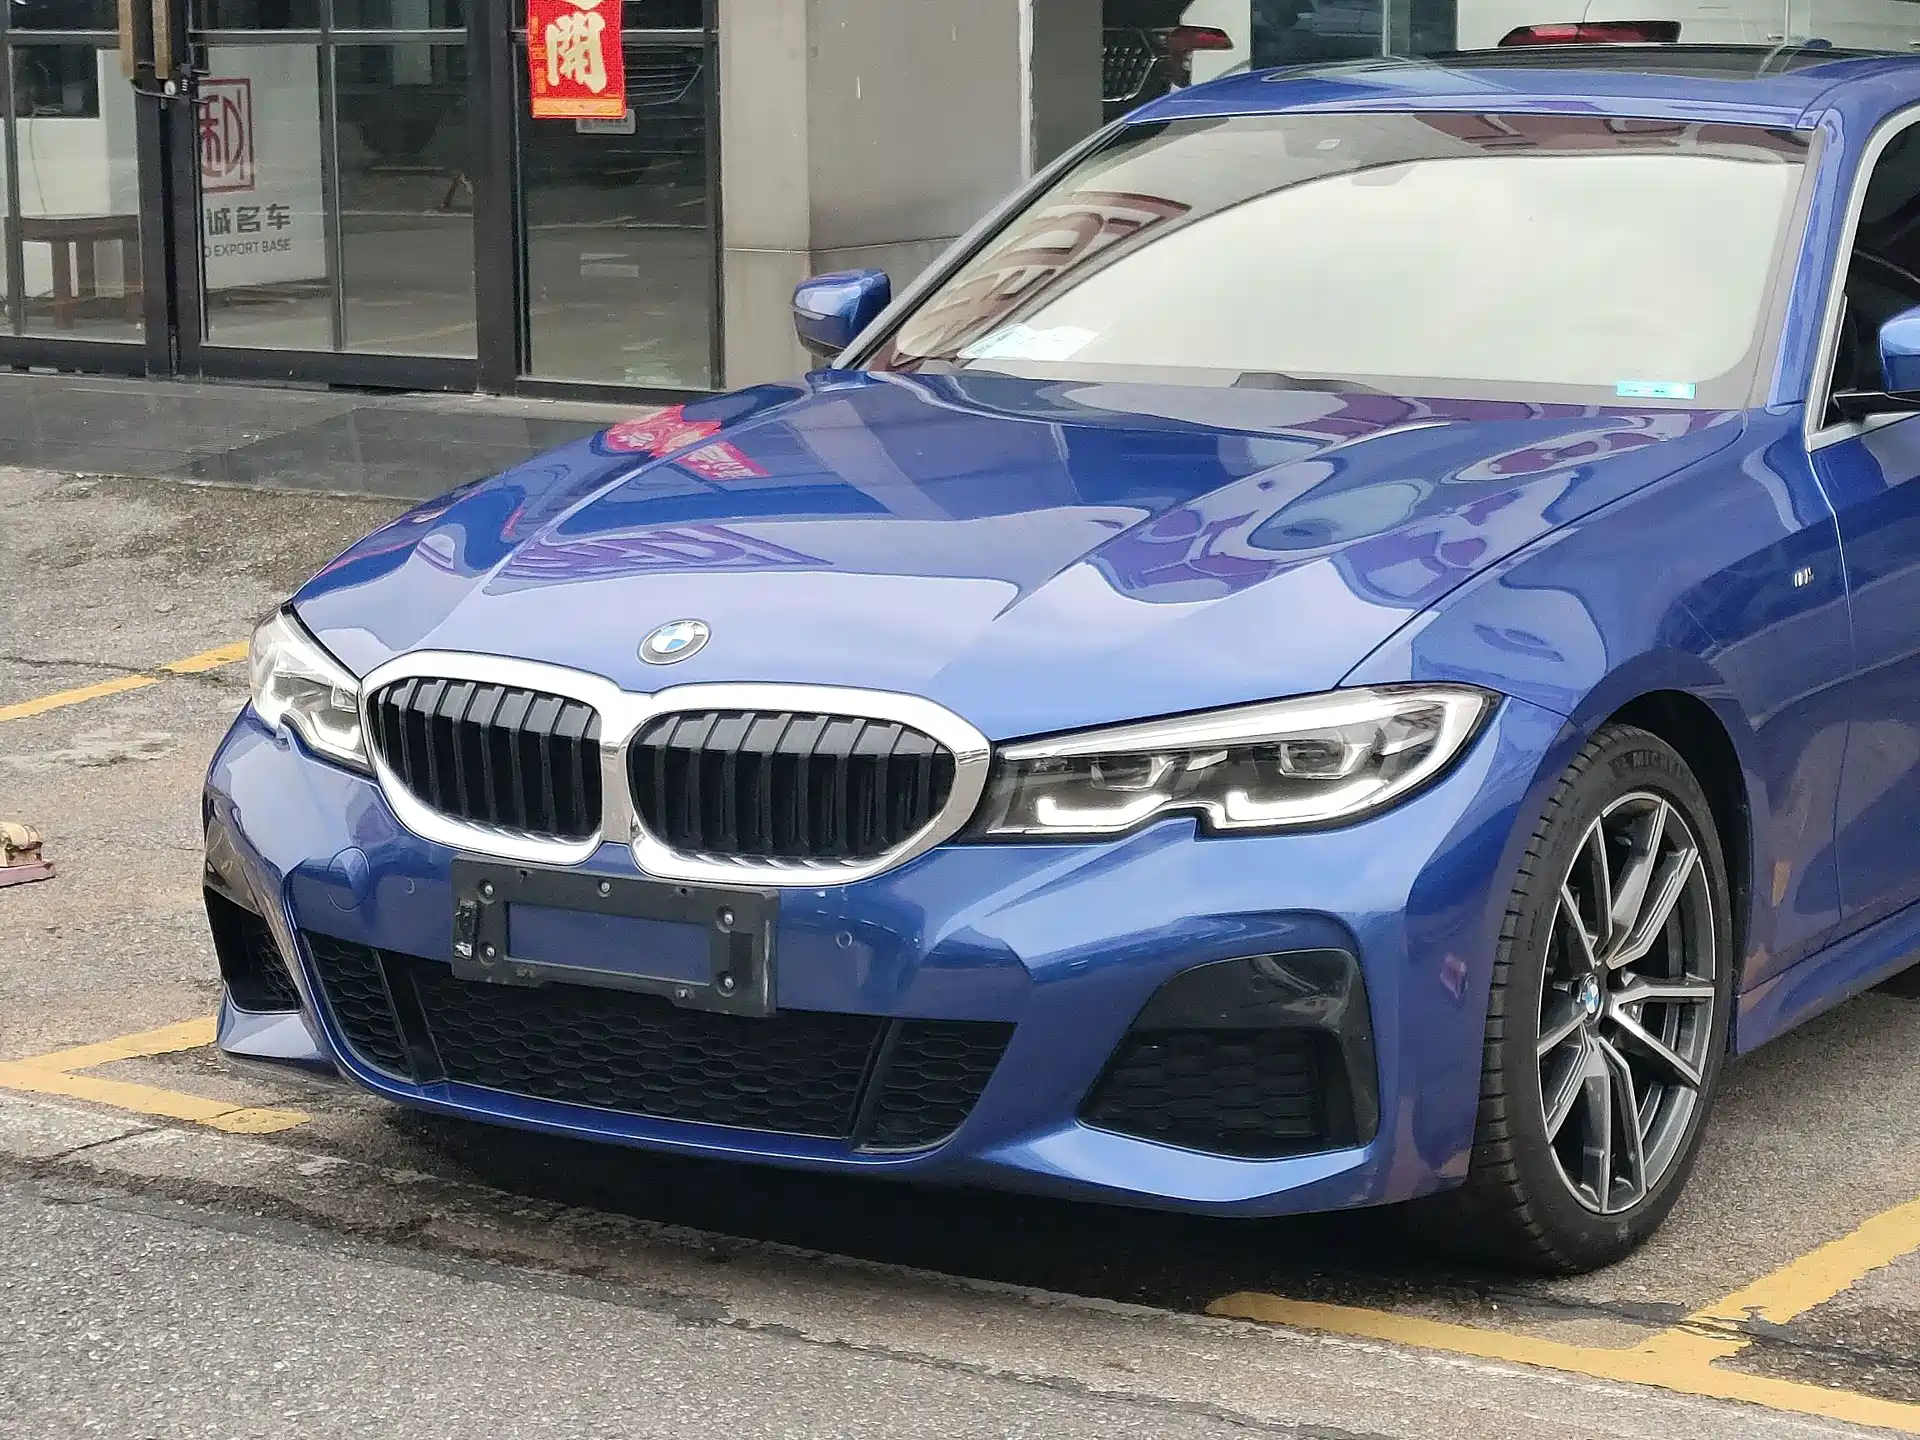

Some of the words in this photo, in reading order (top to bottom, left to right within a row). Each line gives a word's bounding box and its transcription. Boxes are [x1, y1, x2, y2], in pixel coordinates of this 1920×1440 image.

[545, 0, 607, 94] 開
[206, 203, 291, 235] 诚名车
[214, 241, 259, 257] EXPORT
[262, 237, 291, 253] BASE
